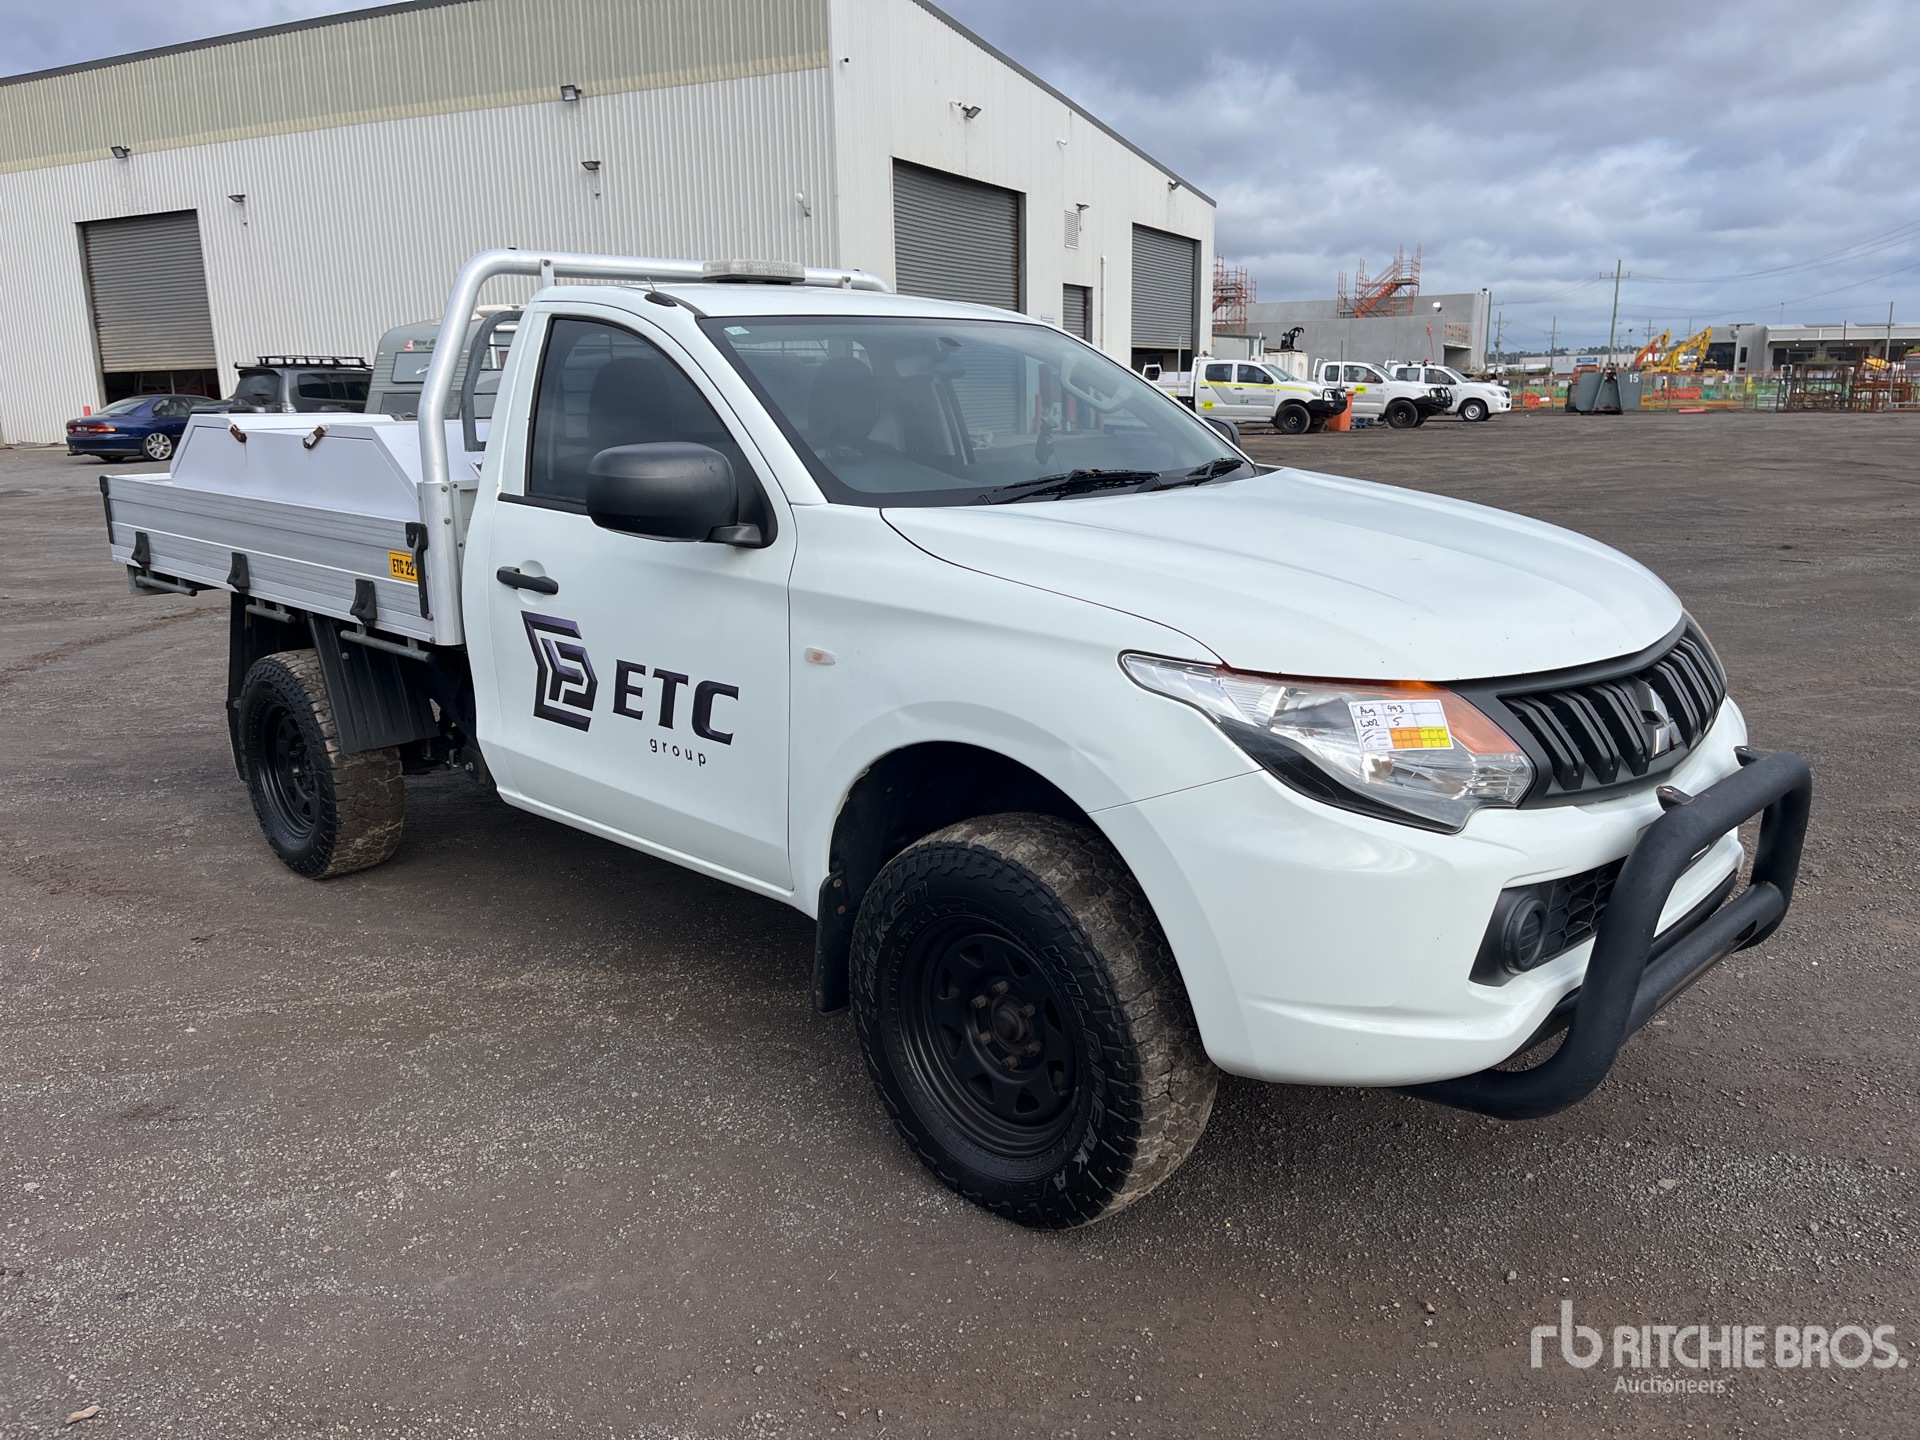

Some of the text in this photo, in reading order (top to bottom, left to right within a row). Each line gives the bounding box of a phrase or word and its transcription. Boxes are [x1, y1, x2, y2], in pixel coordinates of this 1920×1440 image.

[1629, 374, 1639, 383] 15
[392, 558, 415, 576] ETC 22
[612, 659, 739, 746] ETC
[649, 737, 707, 767] group
